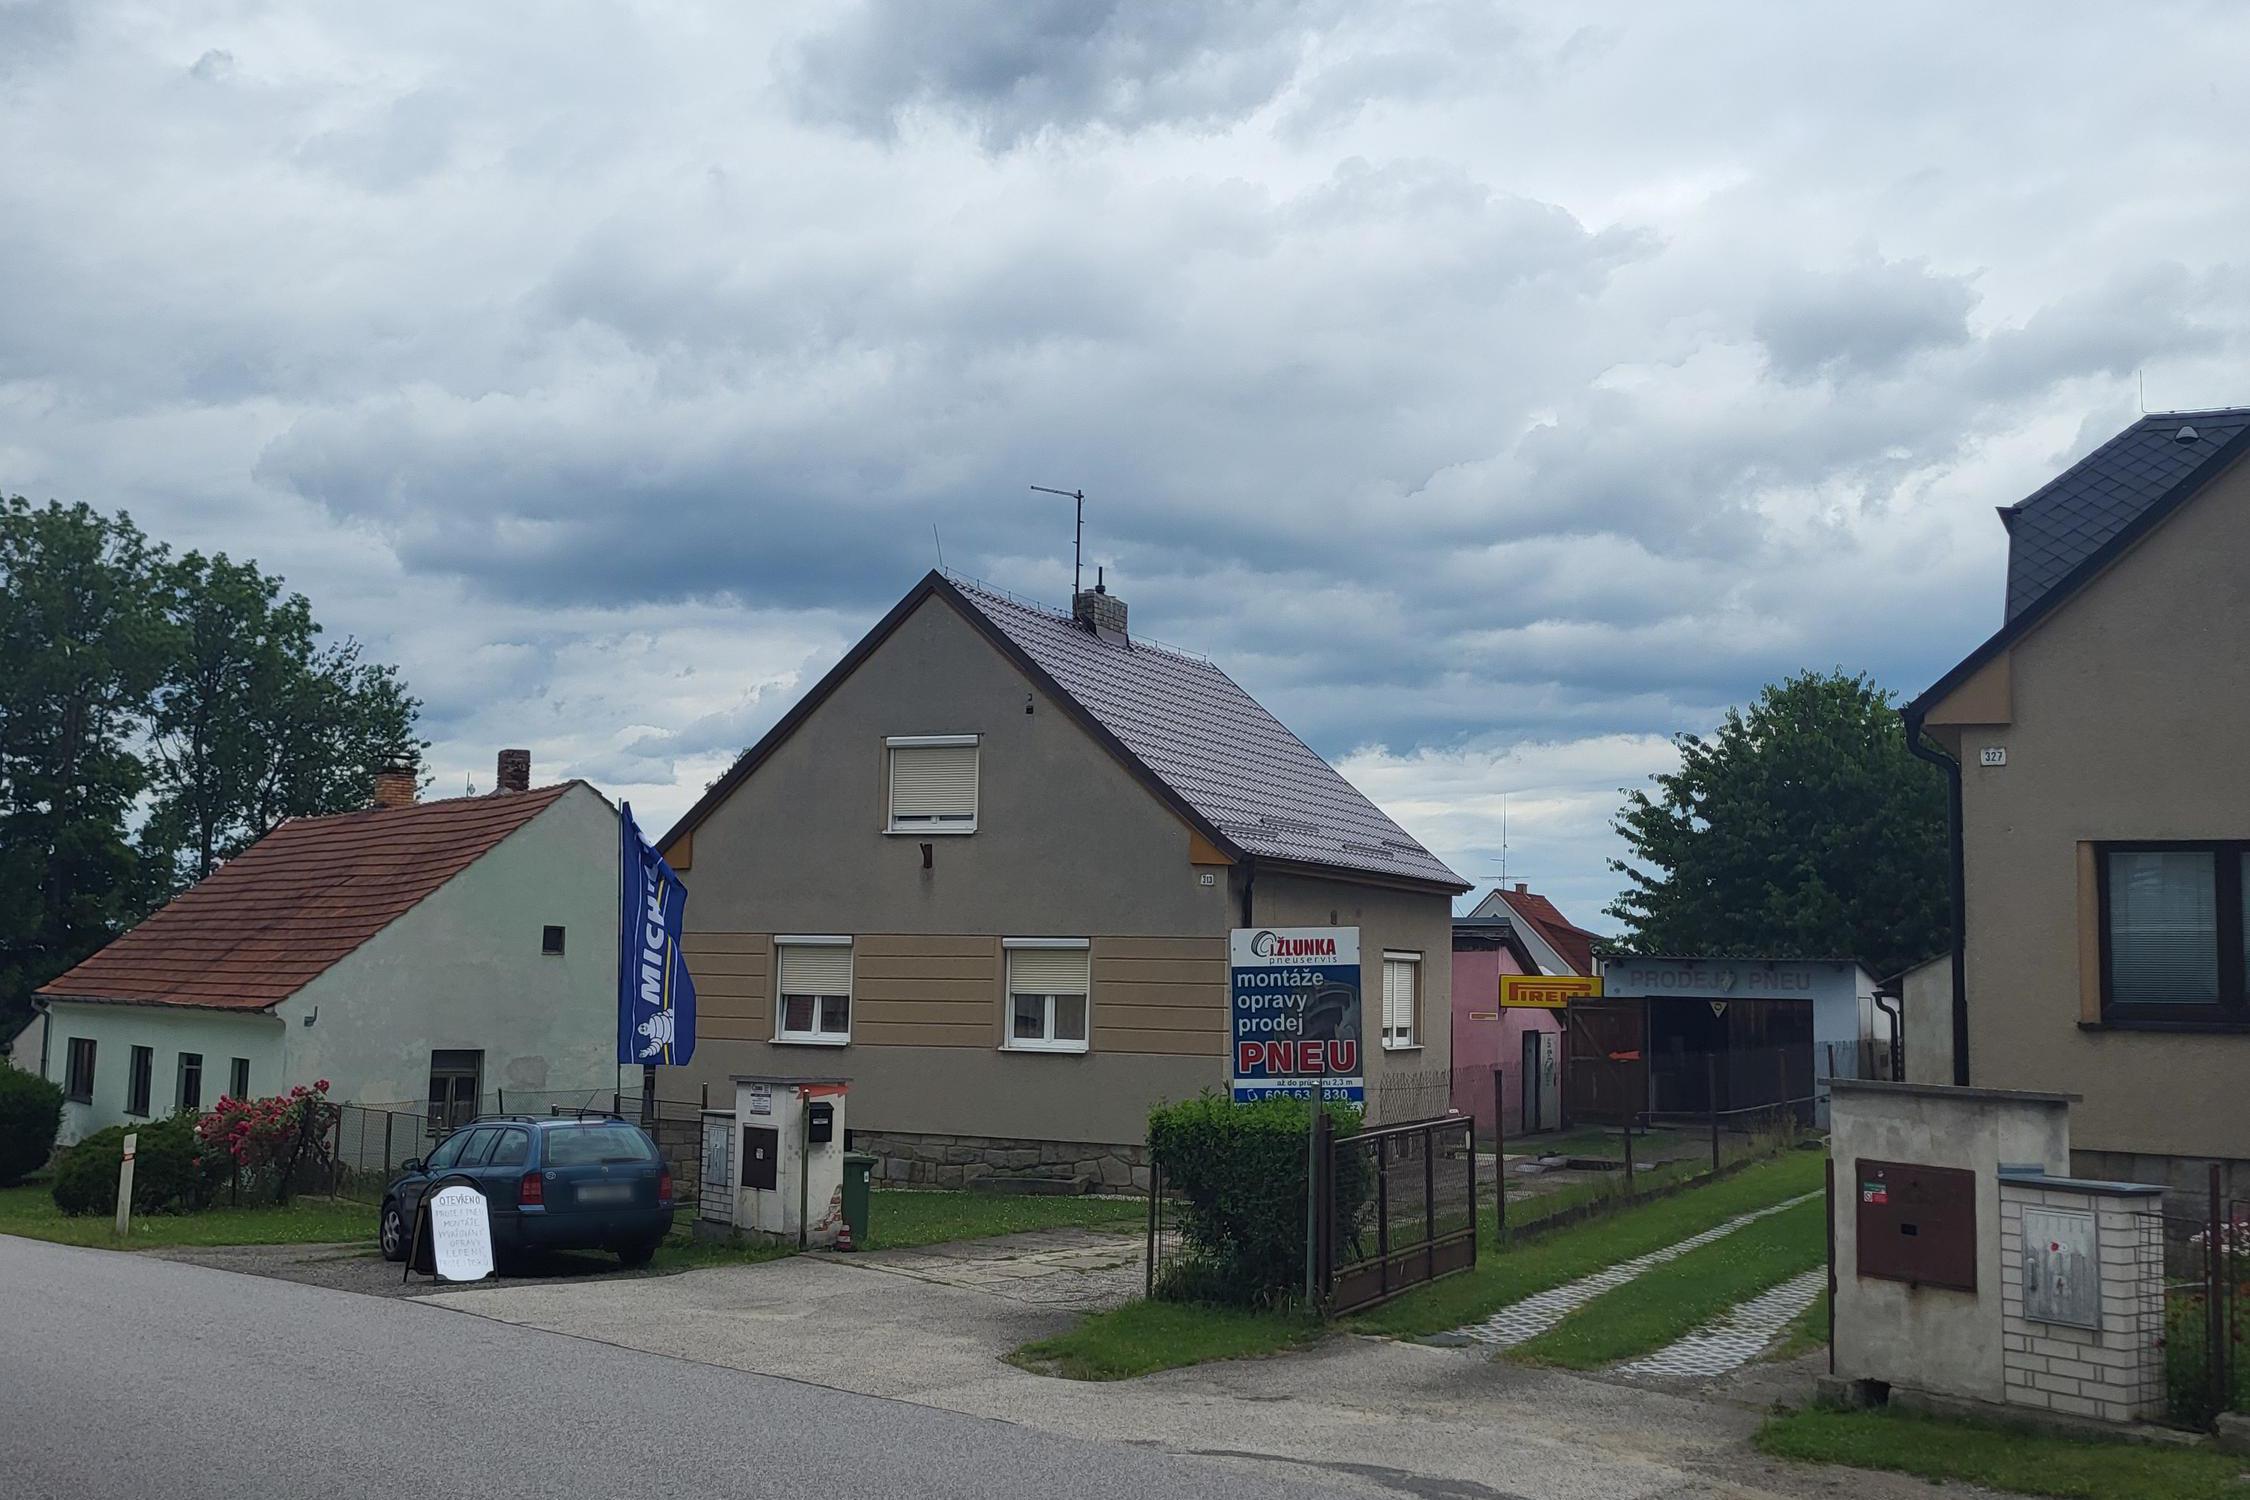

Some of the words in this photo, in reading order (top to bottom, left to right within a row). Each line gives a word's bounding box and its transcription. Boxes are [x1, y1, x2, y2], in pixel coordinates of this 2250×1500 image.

[1985, 751, 2003, 762] 327
[1269, 956, 1338, 965] pneuservis
[1237, 968, 1324, 988] montáže
[1630, 970, 1721, 989] PRODEJ
[1748, 972, 1811, 990] PNEU
[1237, 994, 1308, 1013] opravy
[1238, 1013, 1303, 1037] prodej
[1238, 1040, 1357, 1074] PNEU
[1287, 1079, 1297, 1087] do
[1323, 1089, 1348, 1100] 830
[439, 1194, 481, 1206] OTEVŘENO
